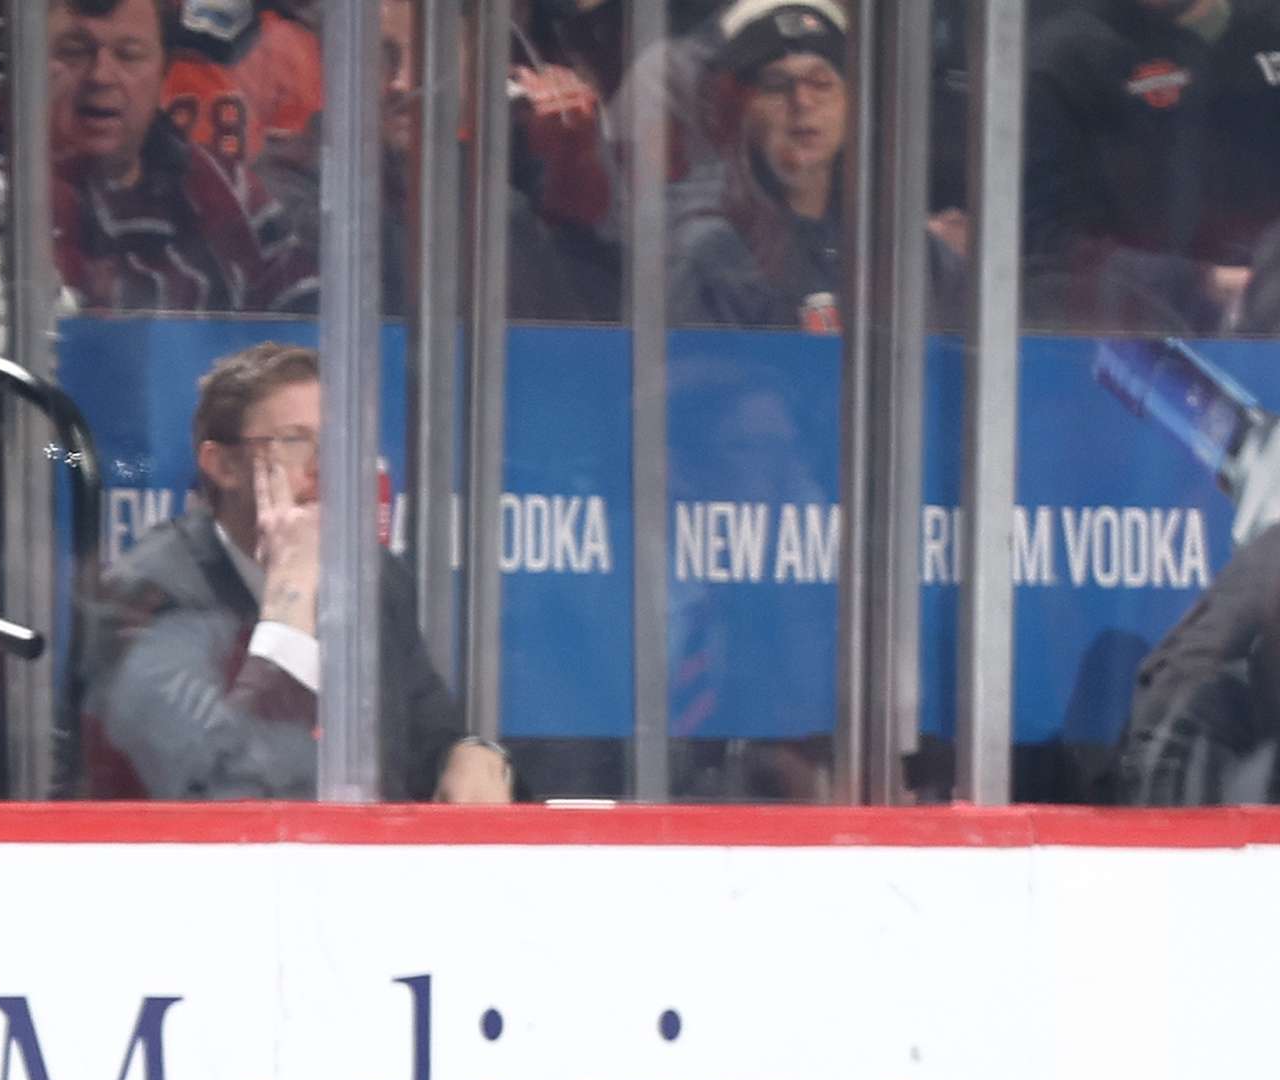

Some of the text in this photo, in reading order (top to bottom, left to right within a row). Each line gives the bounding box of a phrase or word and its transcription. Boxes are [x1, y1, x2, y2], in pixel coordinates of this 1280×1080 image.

[495, 493, 611, 573] ODKA
[675, 502, 767, 583] NEW
[1060, 506, 1208, 588] VODKA
